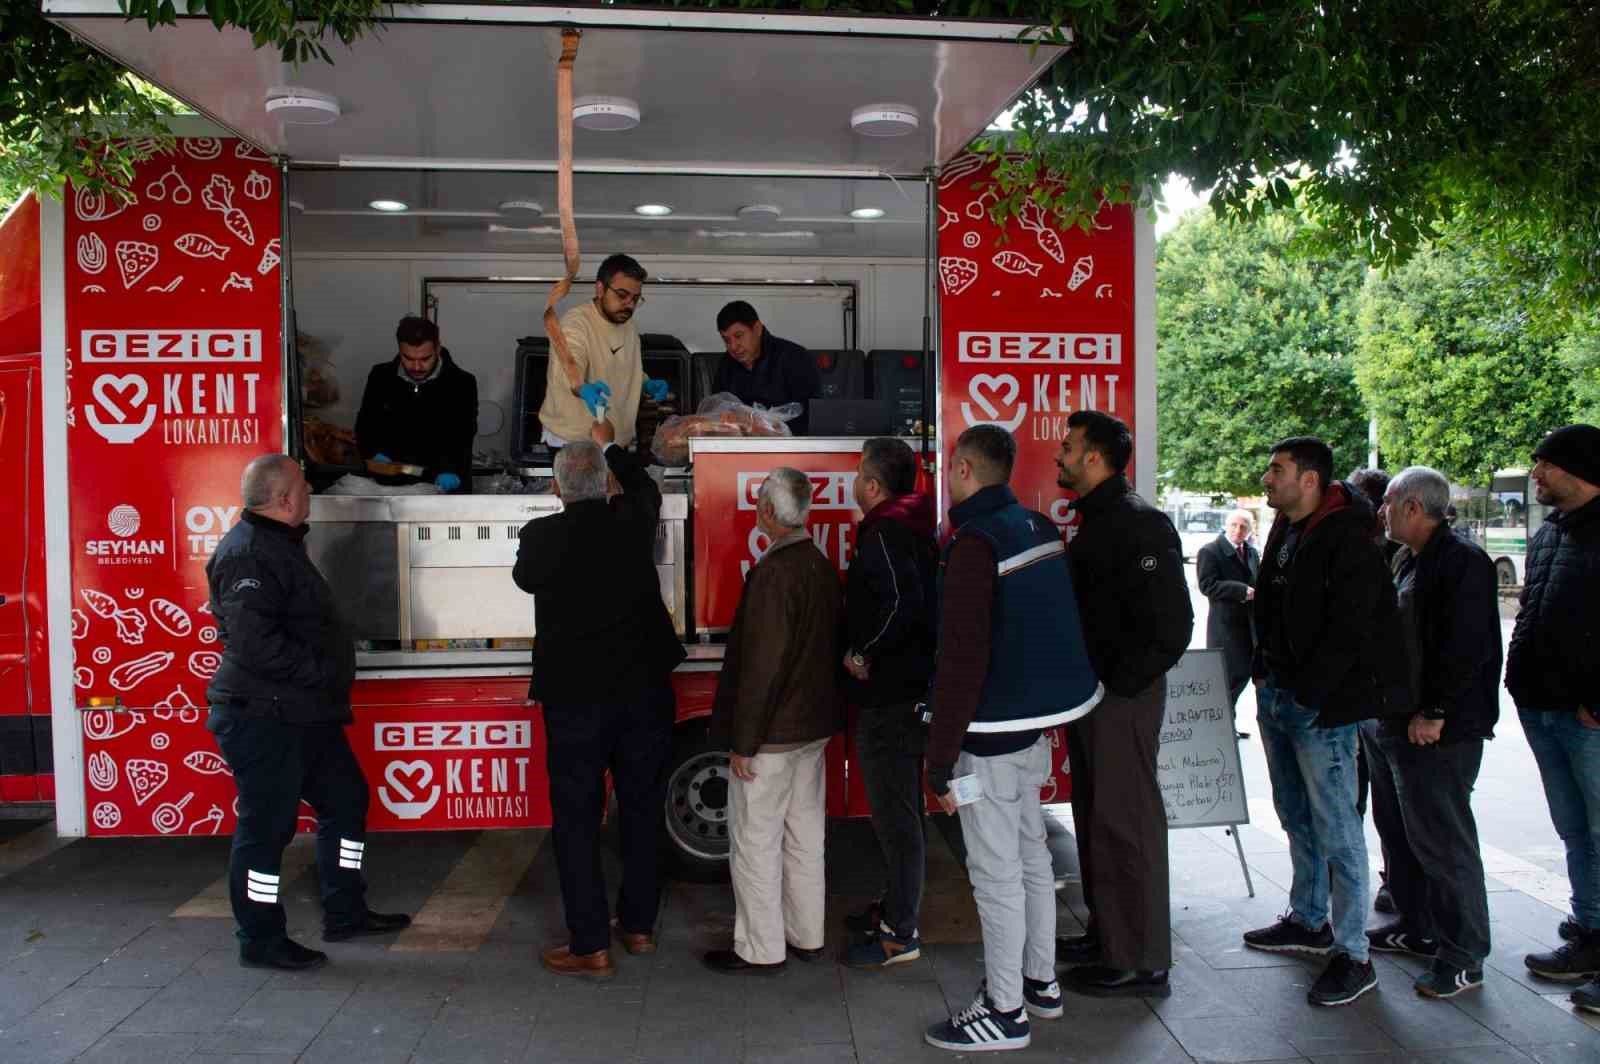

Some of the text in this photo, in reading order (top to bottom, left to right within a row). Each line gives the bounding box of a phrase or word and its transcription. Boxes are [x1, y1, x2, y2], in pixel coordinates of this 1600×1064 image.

[163, 373, 261, 414] KENT
[1032, 373, 1120, 413] KENT
[163, 418, 259, 445] LOKANTASI
[185, 505, 238, 533] OY
[85, 539, 165, 555] SEYHAN
[446, 757, 529, 794] KENT
[446, 795, 529, 819] LOKANTASI
